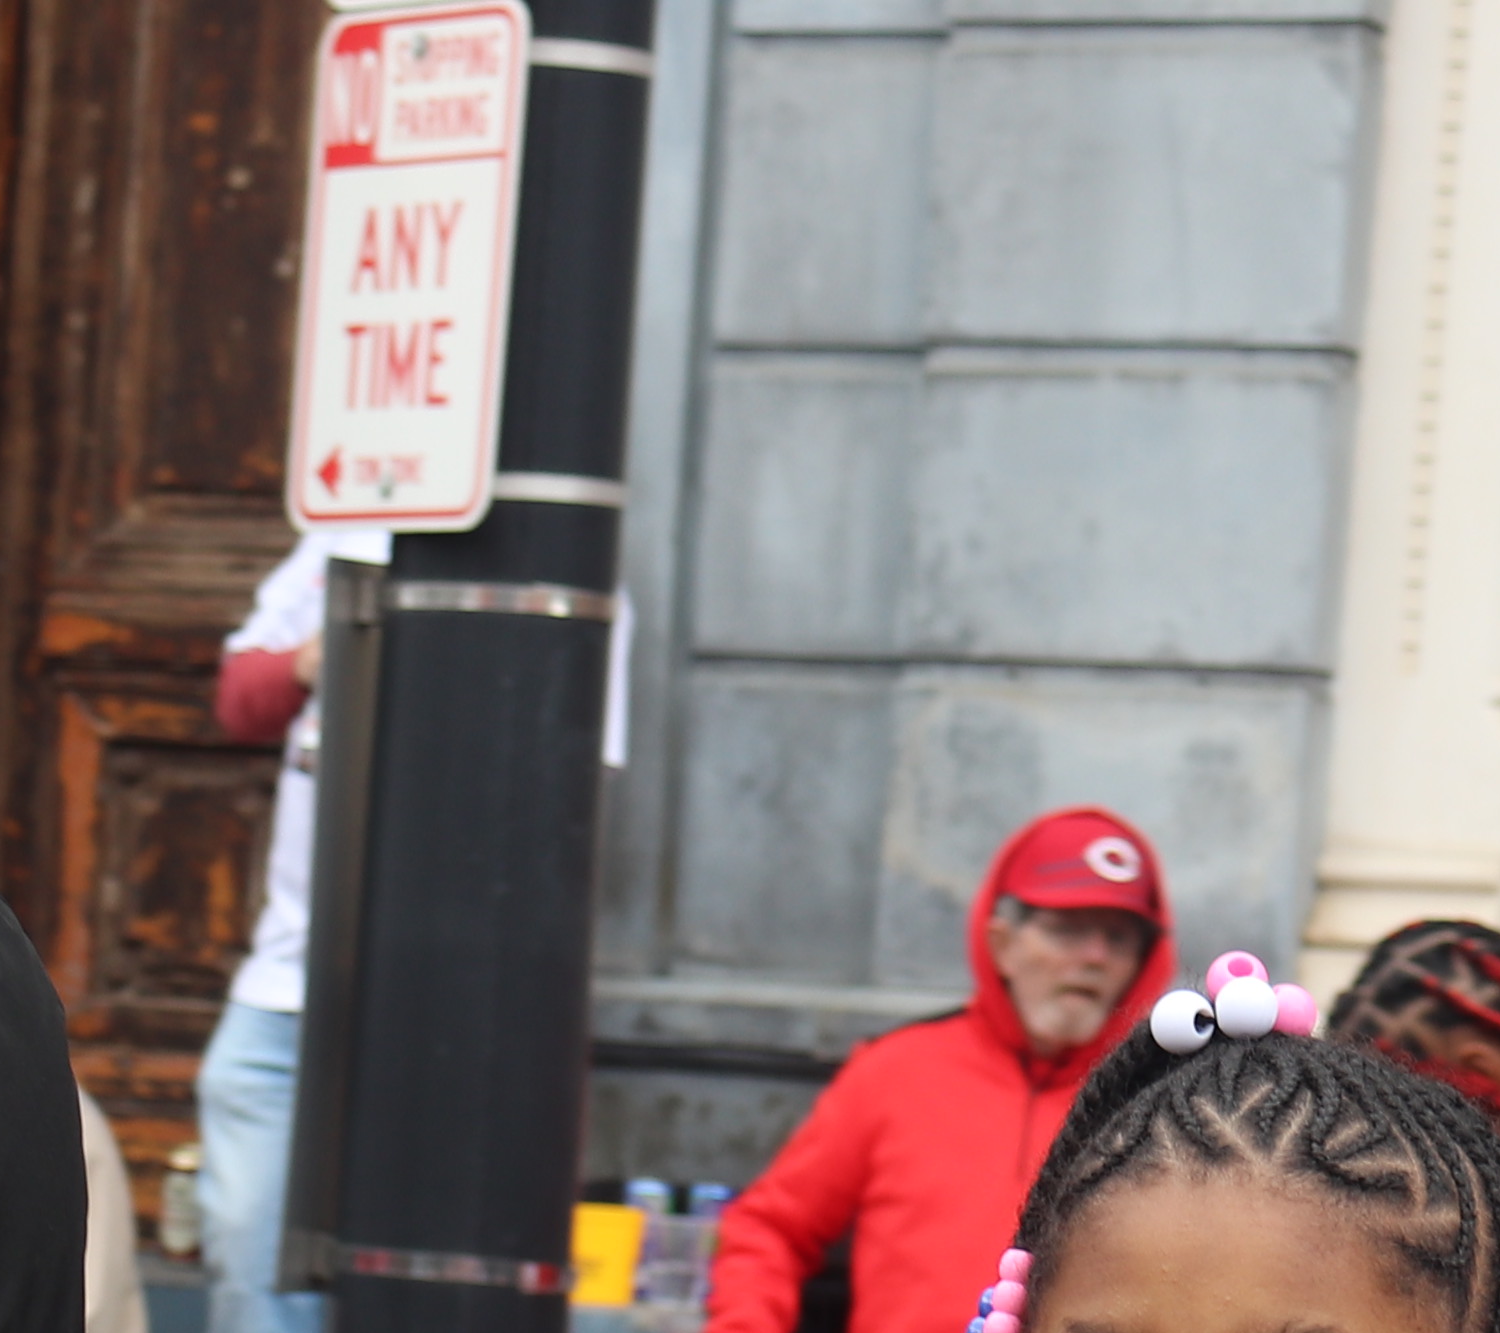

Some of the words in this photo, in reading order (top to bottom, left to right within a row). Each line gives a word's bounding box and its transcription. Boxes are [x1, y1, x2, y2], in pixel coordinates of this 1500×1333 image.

[326, 48, 379, 145] NO
[394, 91, 490, 139] PARKING
[351, 199, 464, 294] ANY
[344, 319, 455, 410] TIME
